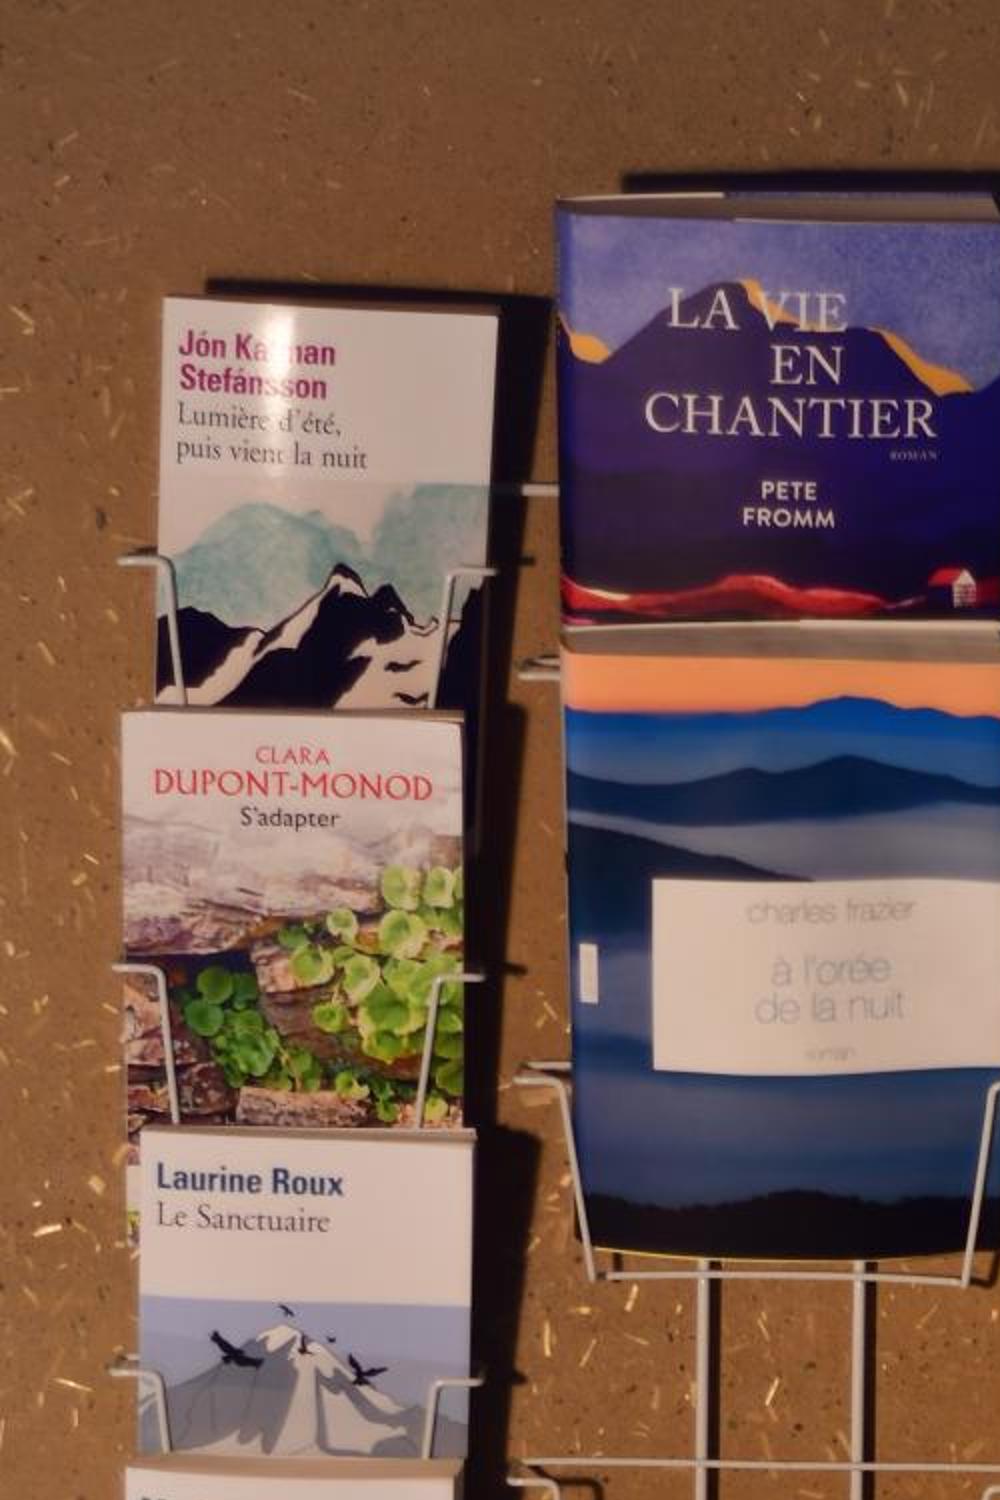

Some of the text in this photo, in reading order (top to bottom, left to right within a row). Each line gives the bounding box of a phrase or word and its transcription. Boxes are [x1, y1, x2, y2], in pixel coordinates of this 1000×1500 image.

[667, 287, 848, 333] LA VIE
[179, 329, 226, 358] Jón
[770, 345, 844, 385] EN
[645, 393, 938, 439] CHANTIER
[177, 437, 367, 469] puis vient la nuit
[761, 481, 817, 501] PETE
[743, 507, 835, 529] FROMM
[255, 746, 330, 765] CLARA
[154, 768, 433, 801] DUPONT-MONOD
[240, 806, 340, 832] S'adapter
[754, 990, 904, 1024] de la nuit
[157, 1162, 345, 1197] Laurine Roux
[157, 1201, 331, 1233] Le Sanctuaire
